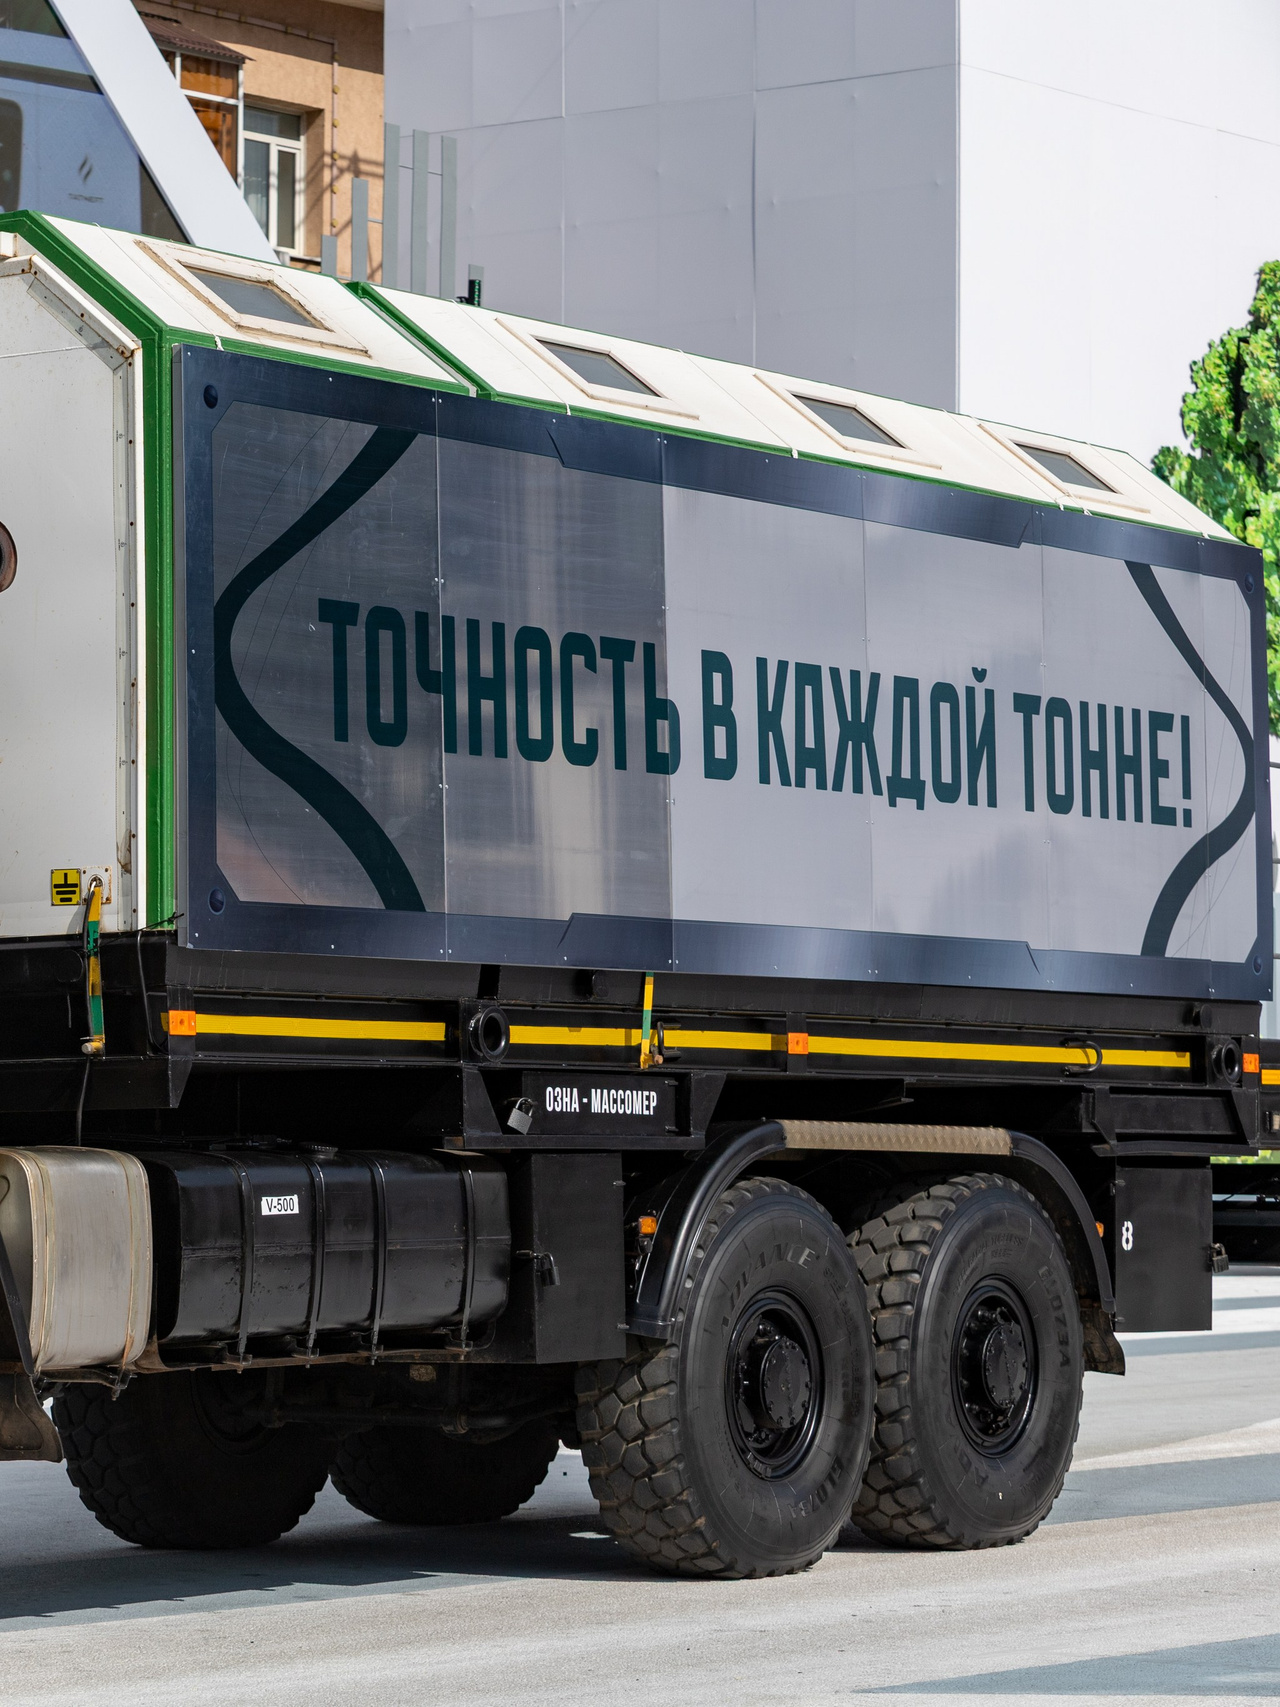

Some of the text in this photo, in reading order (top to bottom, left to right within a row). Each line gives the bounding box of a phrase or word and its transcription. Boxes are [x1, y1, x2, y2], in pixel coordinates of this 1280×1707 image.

[318, 597, 1193, 828] ТОЧНОСТЬ В КАЖДОЙ ТОННЕ!
[545, 1086, 580, 1113] ОЗНА
[591, 1088, 658, 1116] МАССОМЕР
[265, 1197, 295, 1213] V-500
[1121, 1220, 1134, 1251] 8
